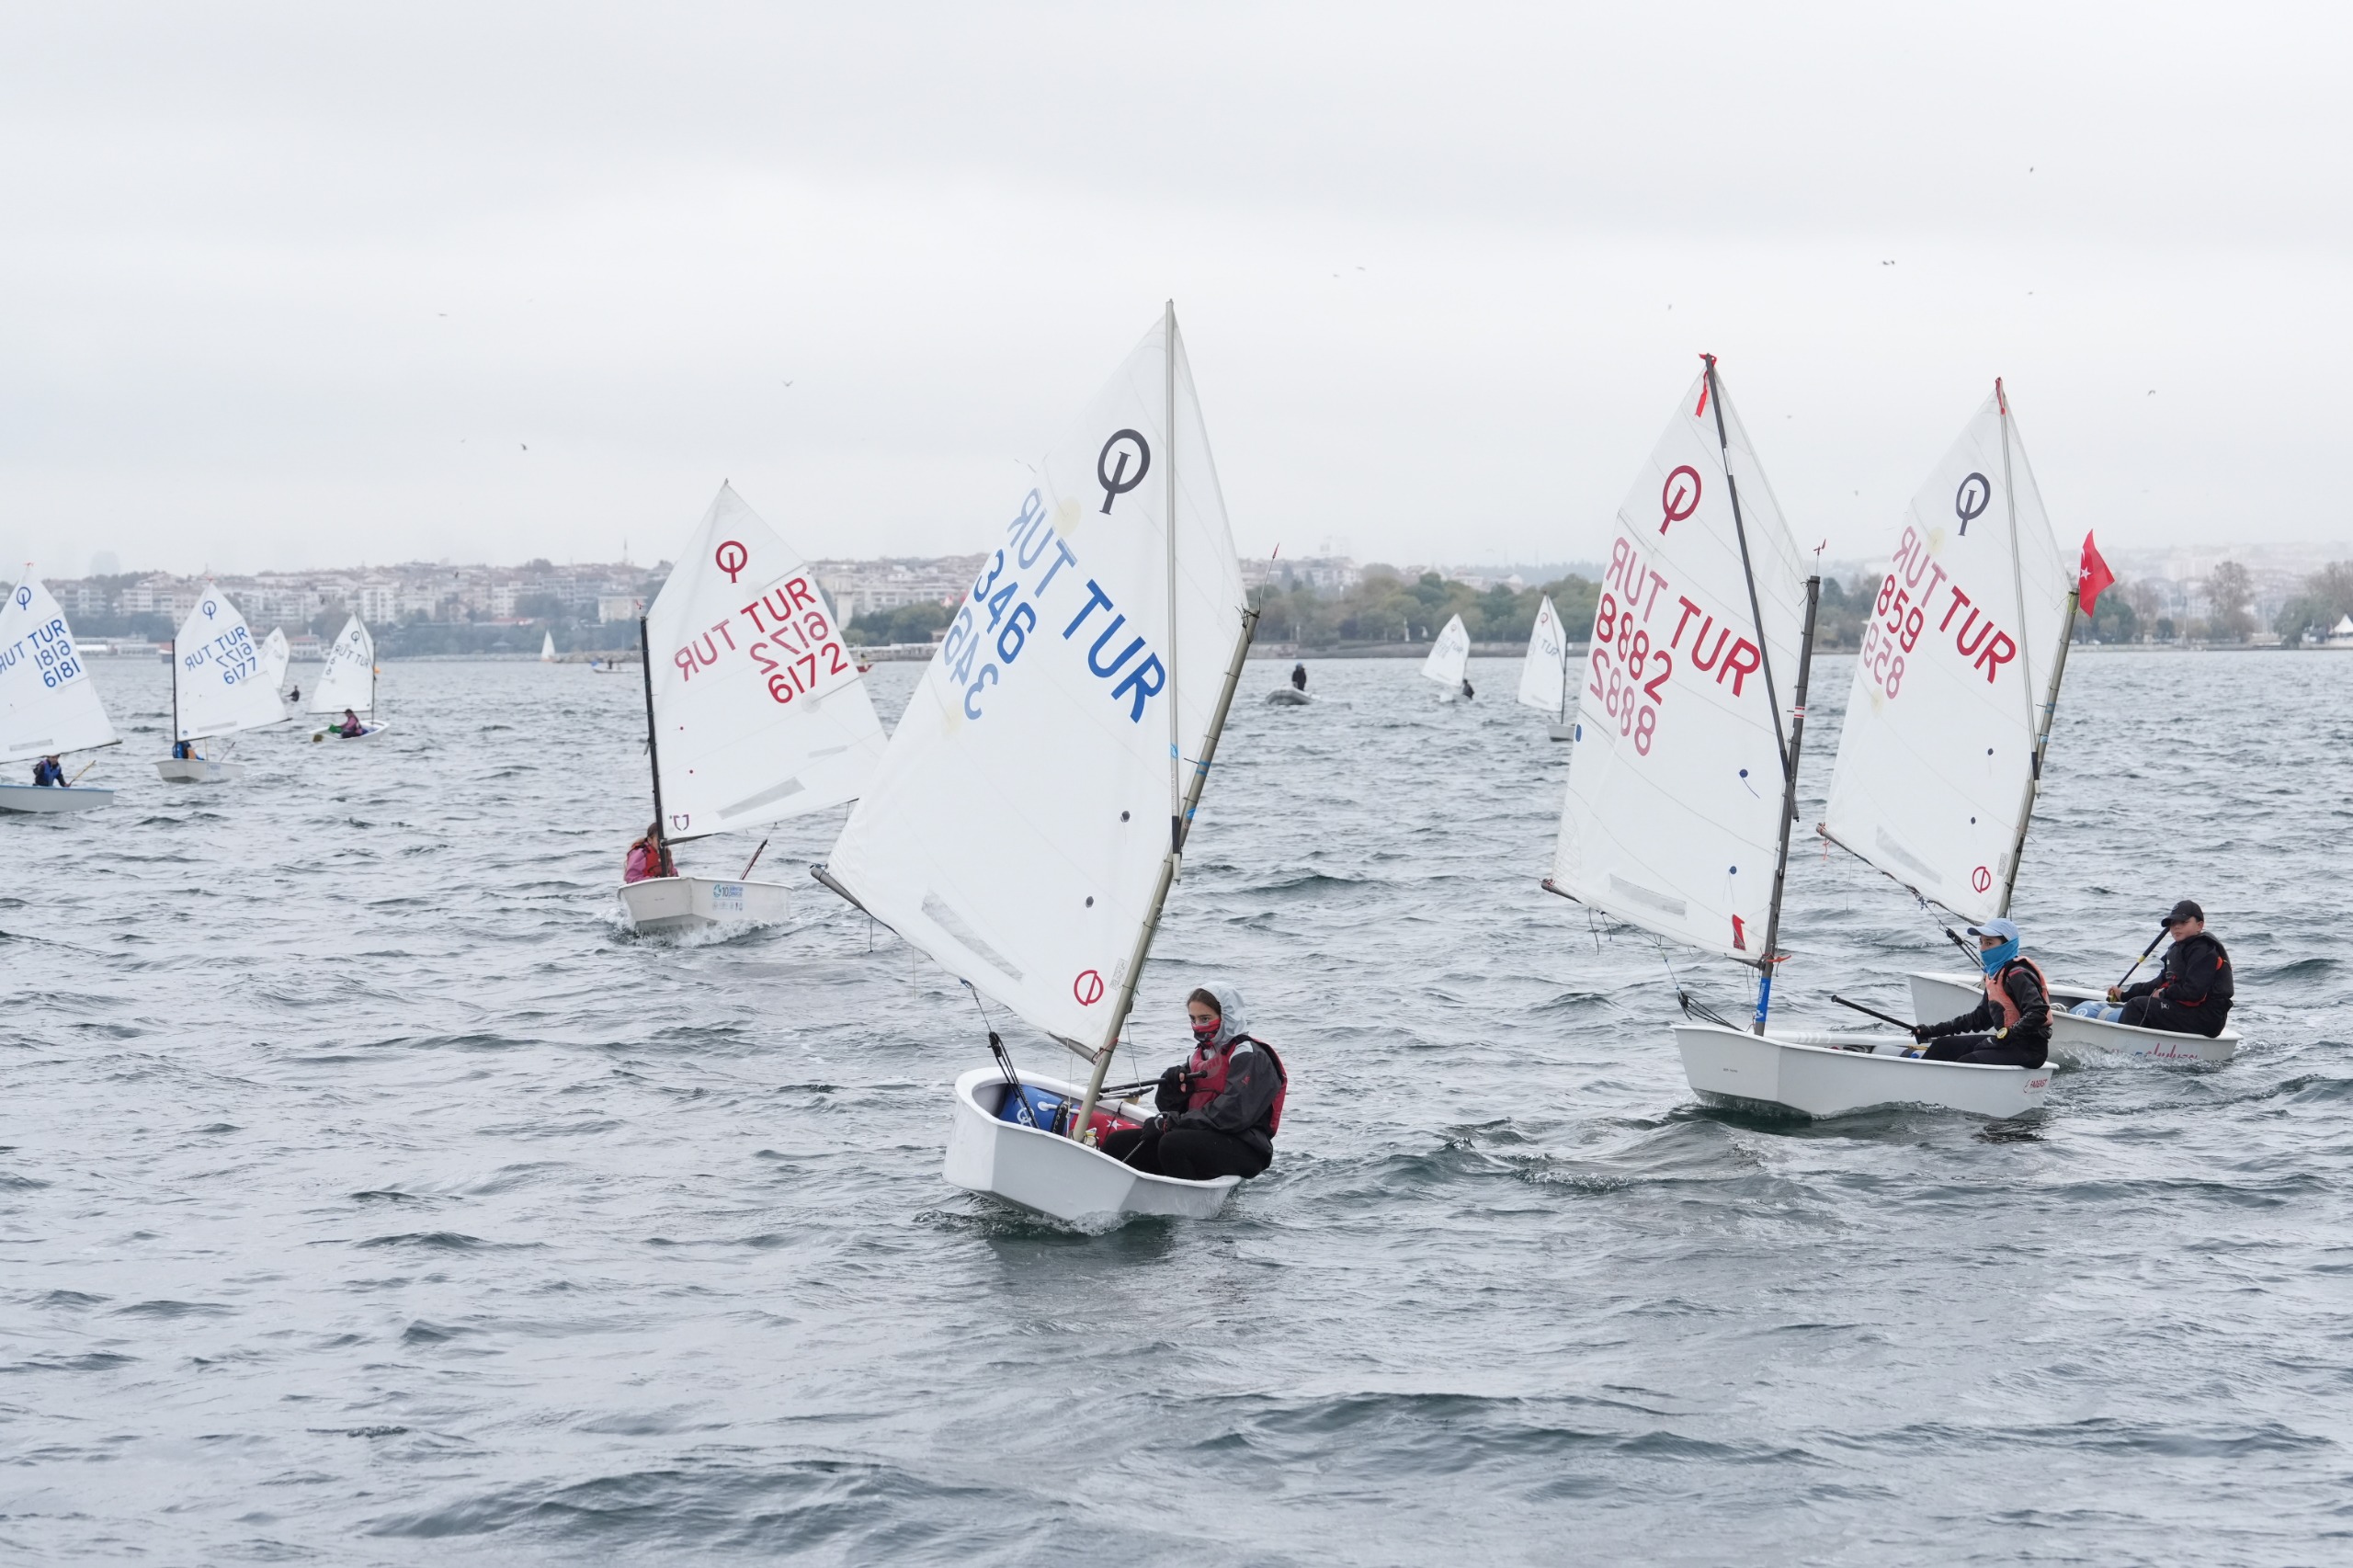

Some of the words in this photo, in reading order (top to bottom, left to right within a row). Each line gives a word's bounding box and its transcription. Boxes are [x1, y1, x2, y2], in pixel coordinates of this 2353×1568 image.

[28, 619, 66, 649] TUR
[214, 627, 248, 651] TUR
[740, 577, 816, 633] TUR
[973, 549, 1036, 664] 346
[1877, 574, 1924, 653] 859
[1939, 585, 2016, 684] TUR
[43, 656, 80, 687] 6181
[223, 656, 256, 684] 6177
[767, 642, 848, 704] 6172
[1062, 579, 1165, 723] TUR
[1596, 593, 1672, 706] 8882
[1670, 595, 1761, 698] TUR
